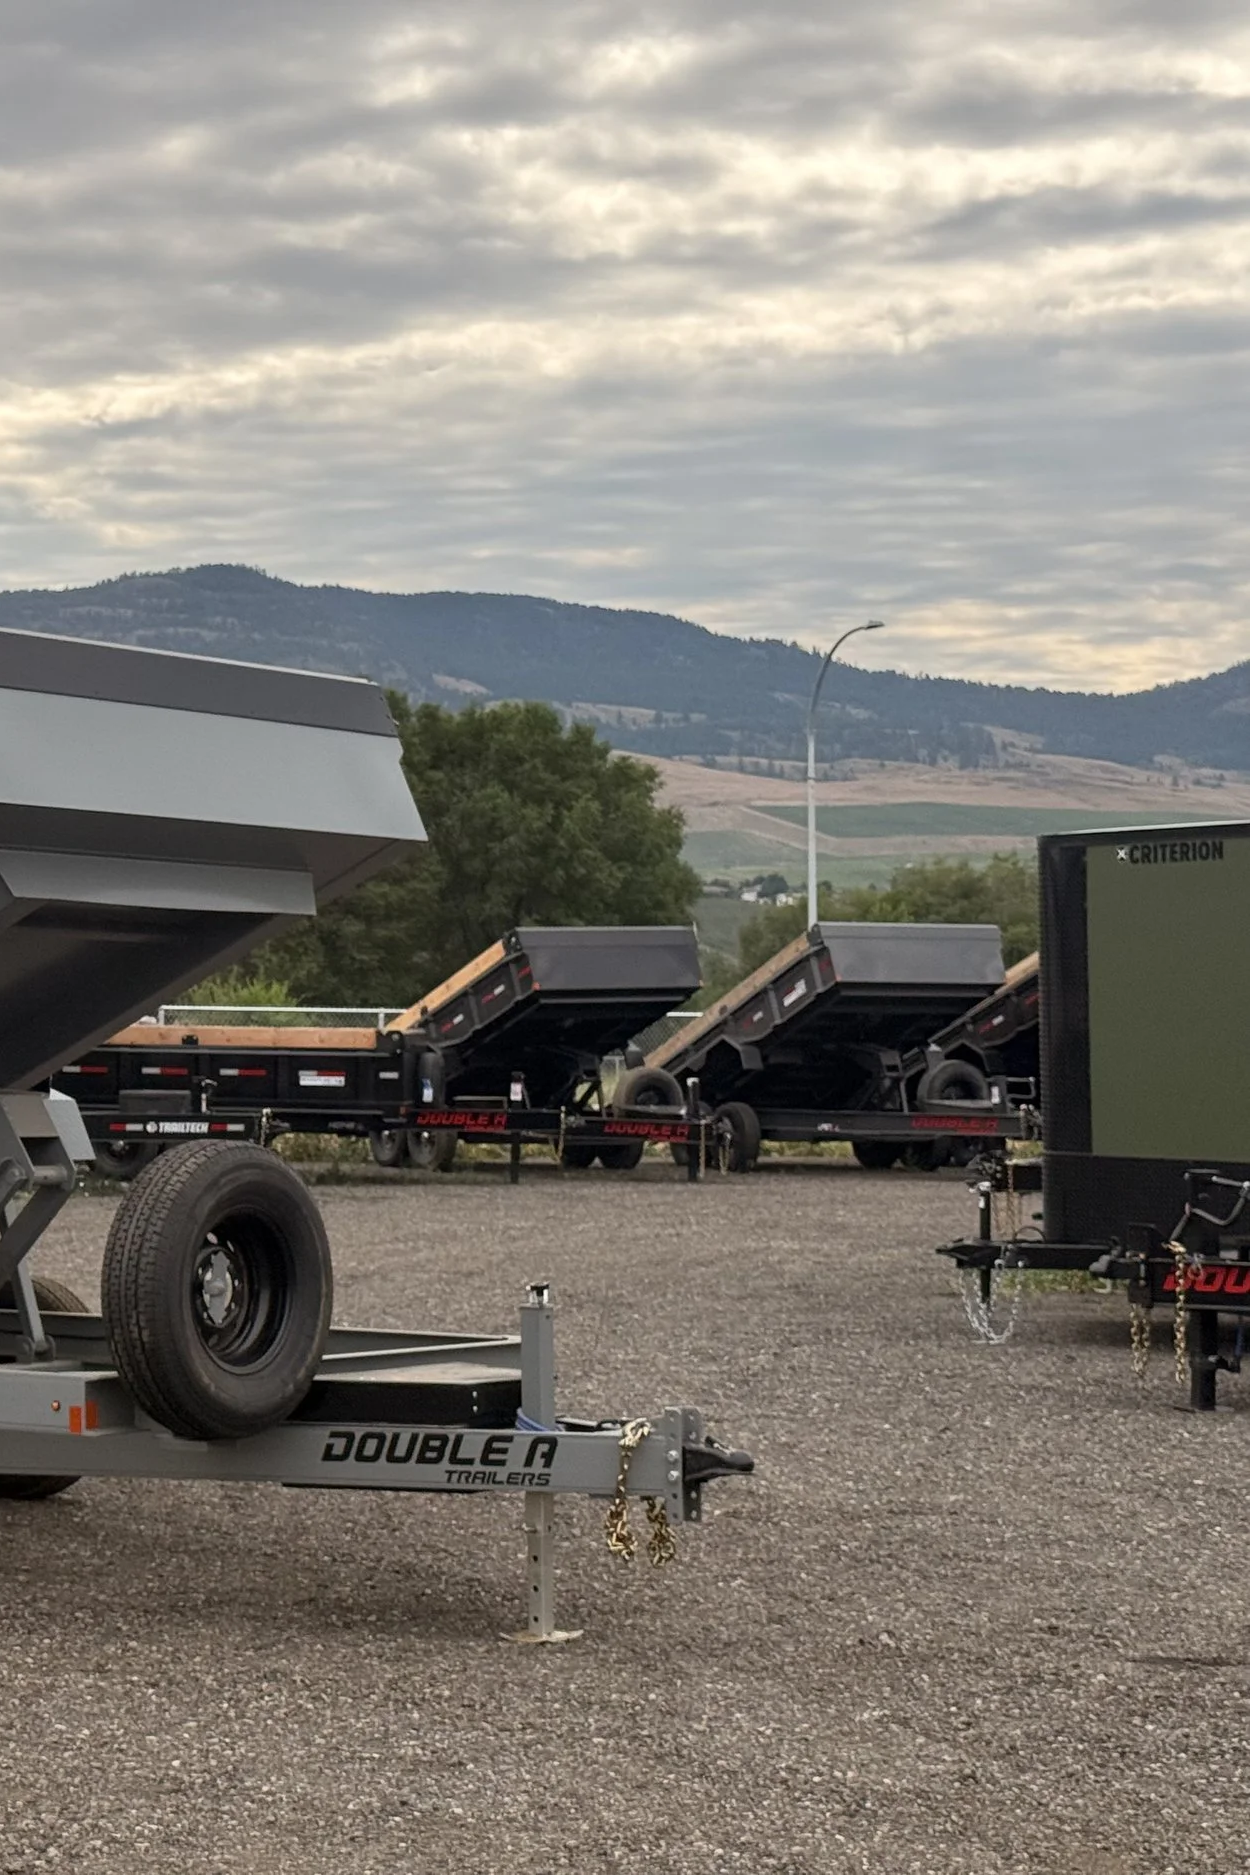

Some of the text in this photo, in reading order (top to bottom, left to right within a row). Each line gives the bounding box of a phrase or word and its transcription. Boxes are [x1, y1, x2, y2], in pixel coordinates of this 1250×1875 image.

[1130, 841, 1224, 864] CRITERION
[159, 1121, 209, 1134] TRAILTECH
[321, 1431, 558, 1468] DOUBLE A
[445, 1469, 551, 1487] TRAILERS
